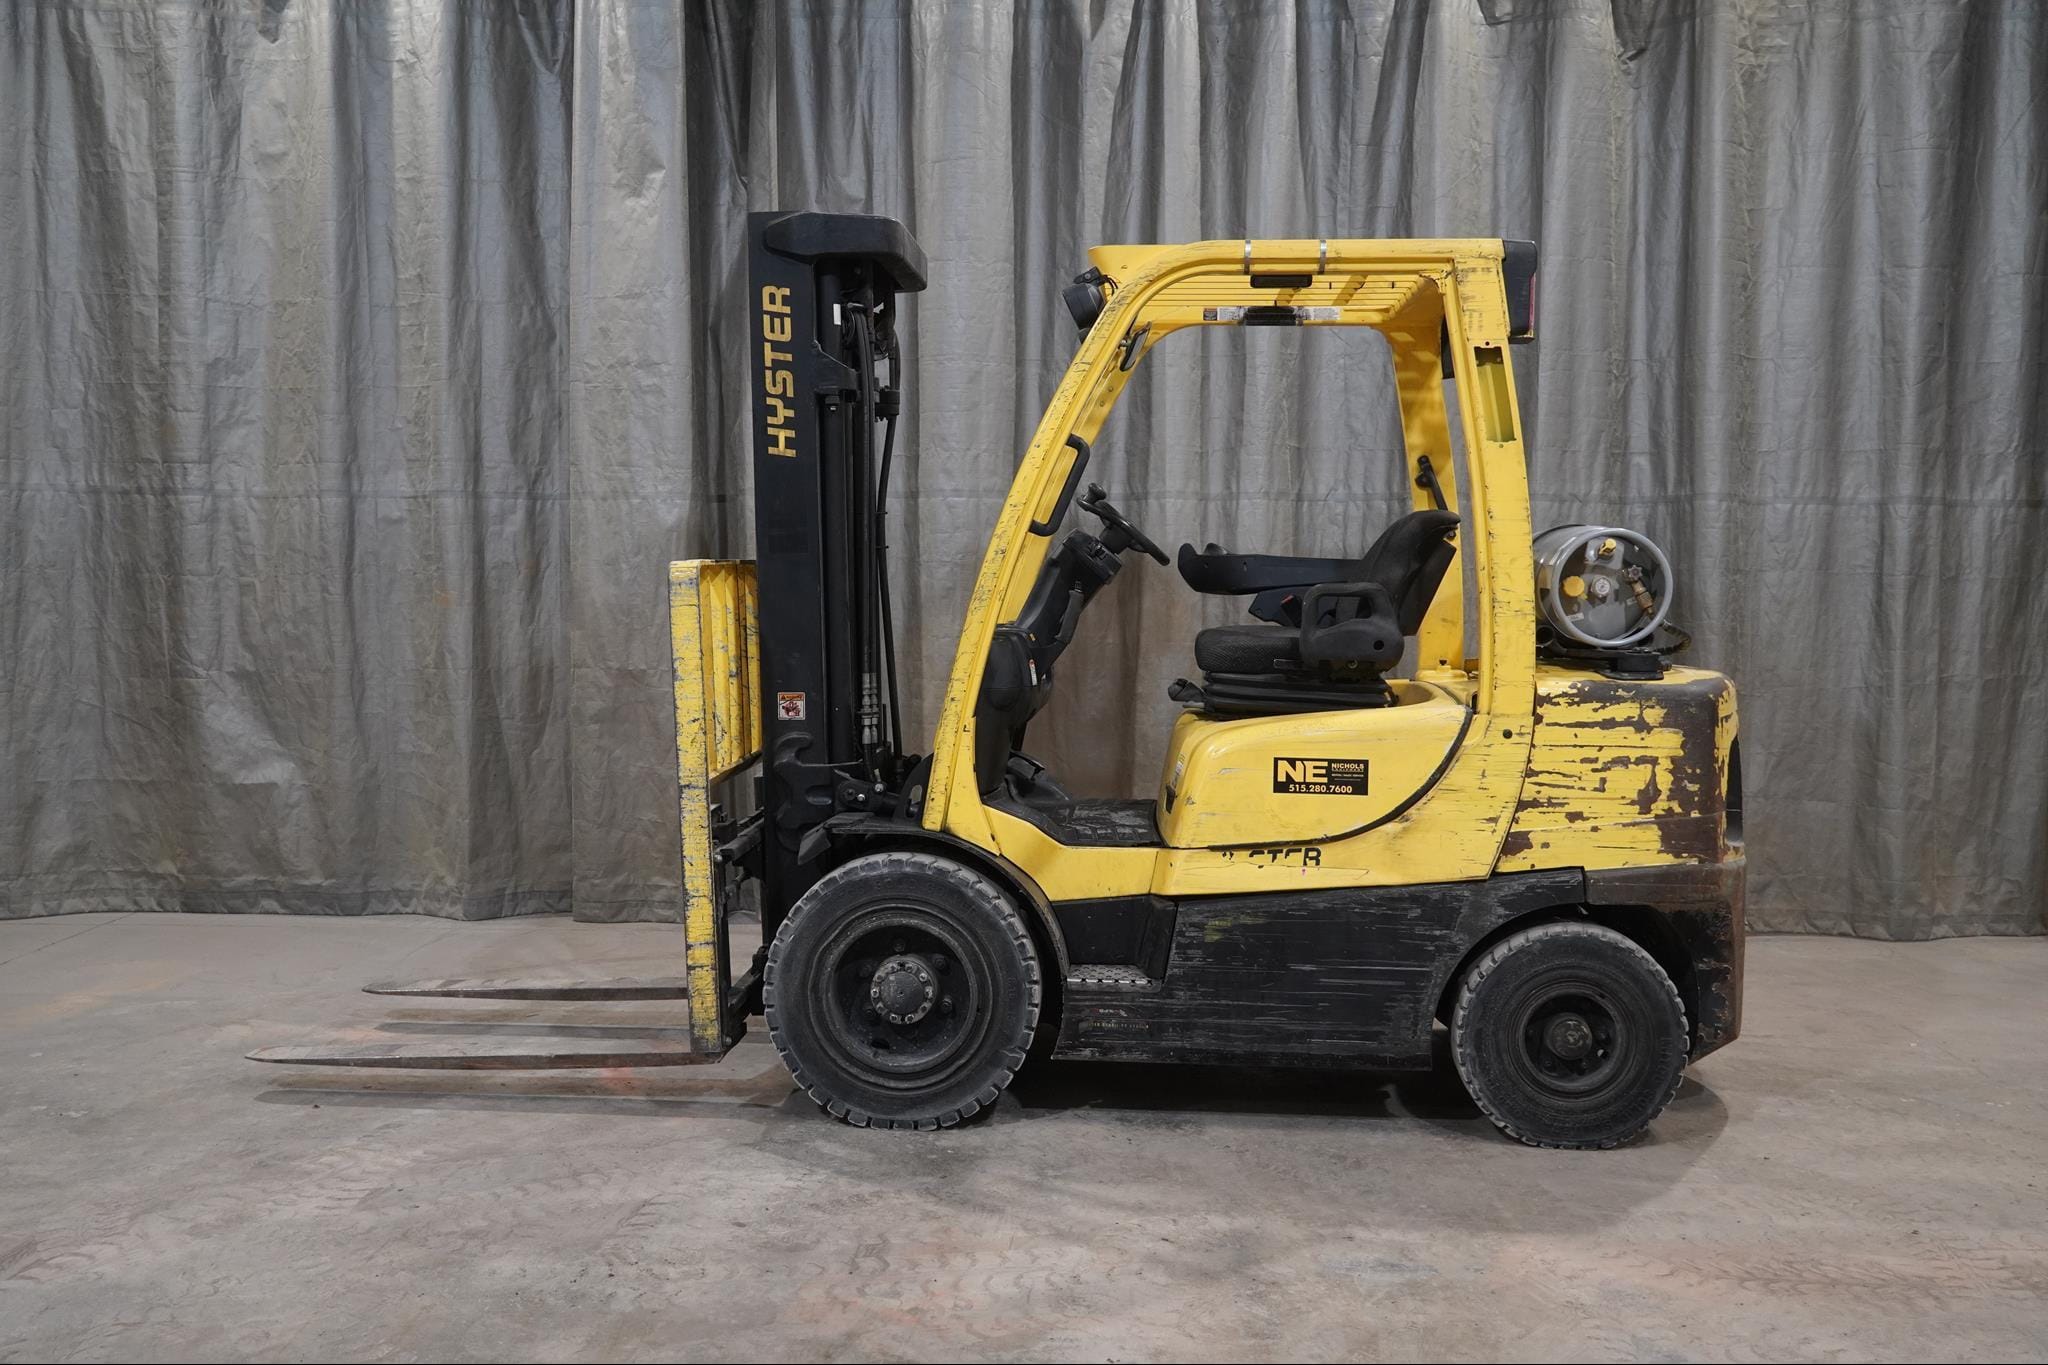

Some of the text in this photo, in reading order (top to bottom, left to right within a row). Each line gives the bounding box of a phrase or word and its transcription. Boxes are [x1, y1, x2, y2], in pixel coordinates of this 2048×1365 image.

[762, 285, 797, 458] HYSTER
[1277, 760, 1328, 783] NE
[1288, 784, 1353, 793] 515.280.7600
